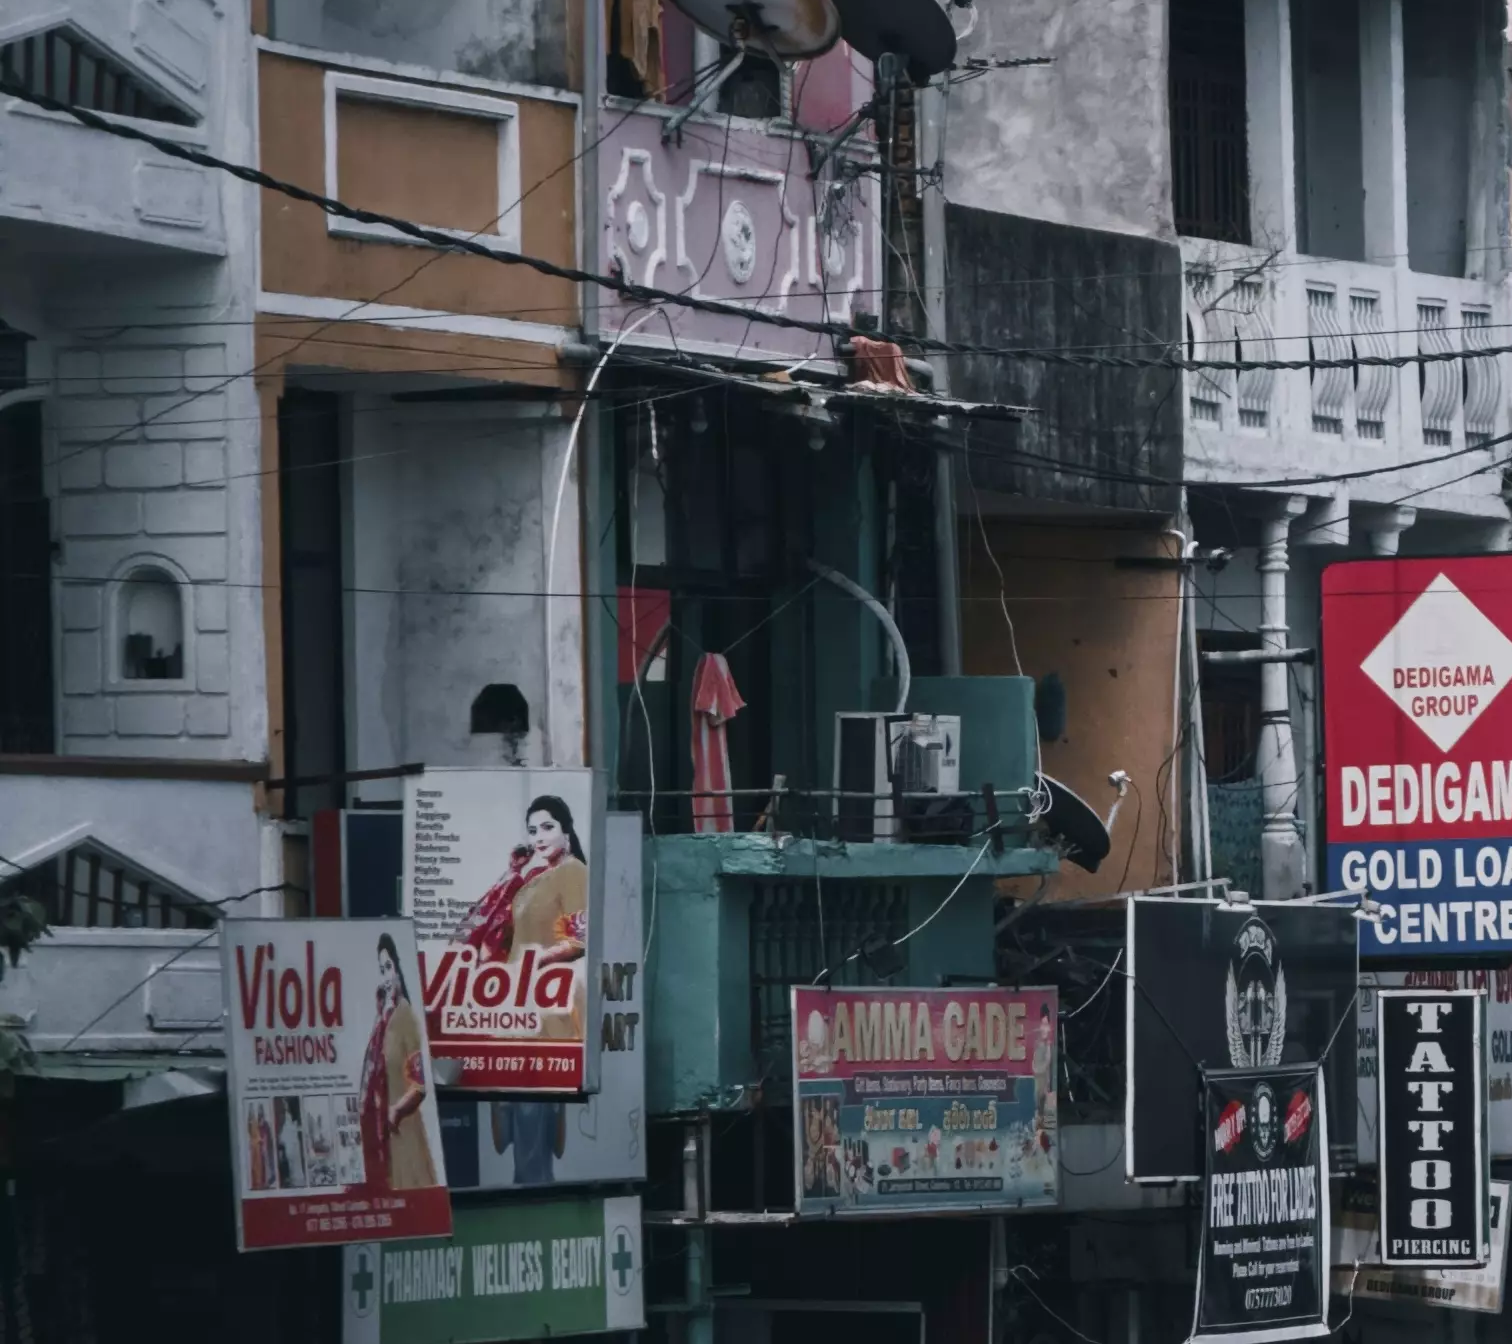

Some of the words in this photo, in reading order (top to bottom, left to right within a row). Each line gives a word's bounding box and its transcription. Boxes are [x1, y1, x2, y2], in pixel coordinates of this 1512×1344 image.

[1393, 665, 1495, 689] DEDIGAMA
[1411, 694, 1479, 717] GROUP
[1342, 848, 1442, 891] GOLD
[236, 940, 343, 1030] Viola
[417, 949, 574, 1008] Viola
[446, 1011, 537, 1029] FASHIONS
[831, 1001, 935, 1062] AMMA
[944, 1001, 1027, 1062] CADE
[255, 1034, 337, 1065] FASHIONS
[1405, 1002, 1455, 1229] TATTOO
[1210, 1172, 1235, 1228] FREE
[1236, 1169, 1270, 1226] TATTOO
[1270, 1167, 1288, 1224] FOR
[383, 1247, 463, 1304] PHARMACY
[471, 1240, 544, 1297] WELLNESS
[551, 1236, 602, 1290] BEAUTY
[1392, 1239, 1471, 1256] PIERCING
